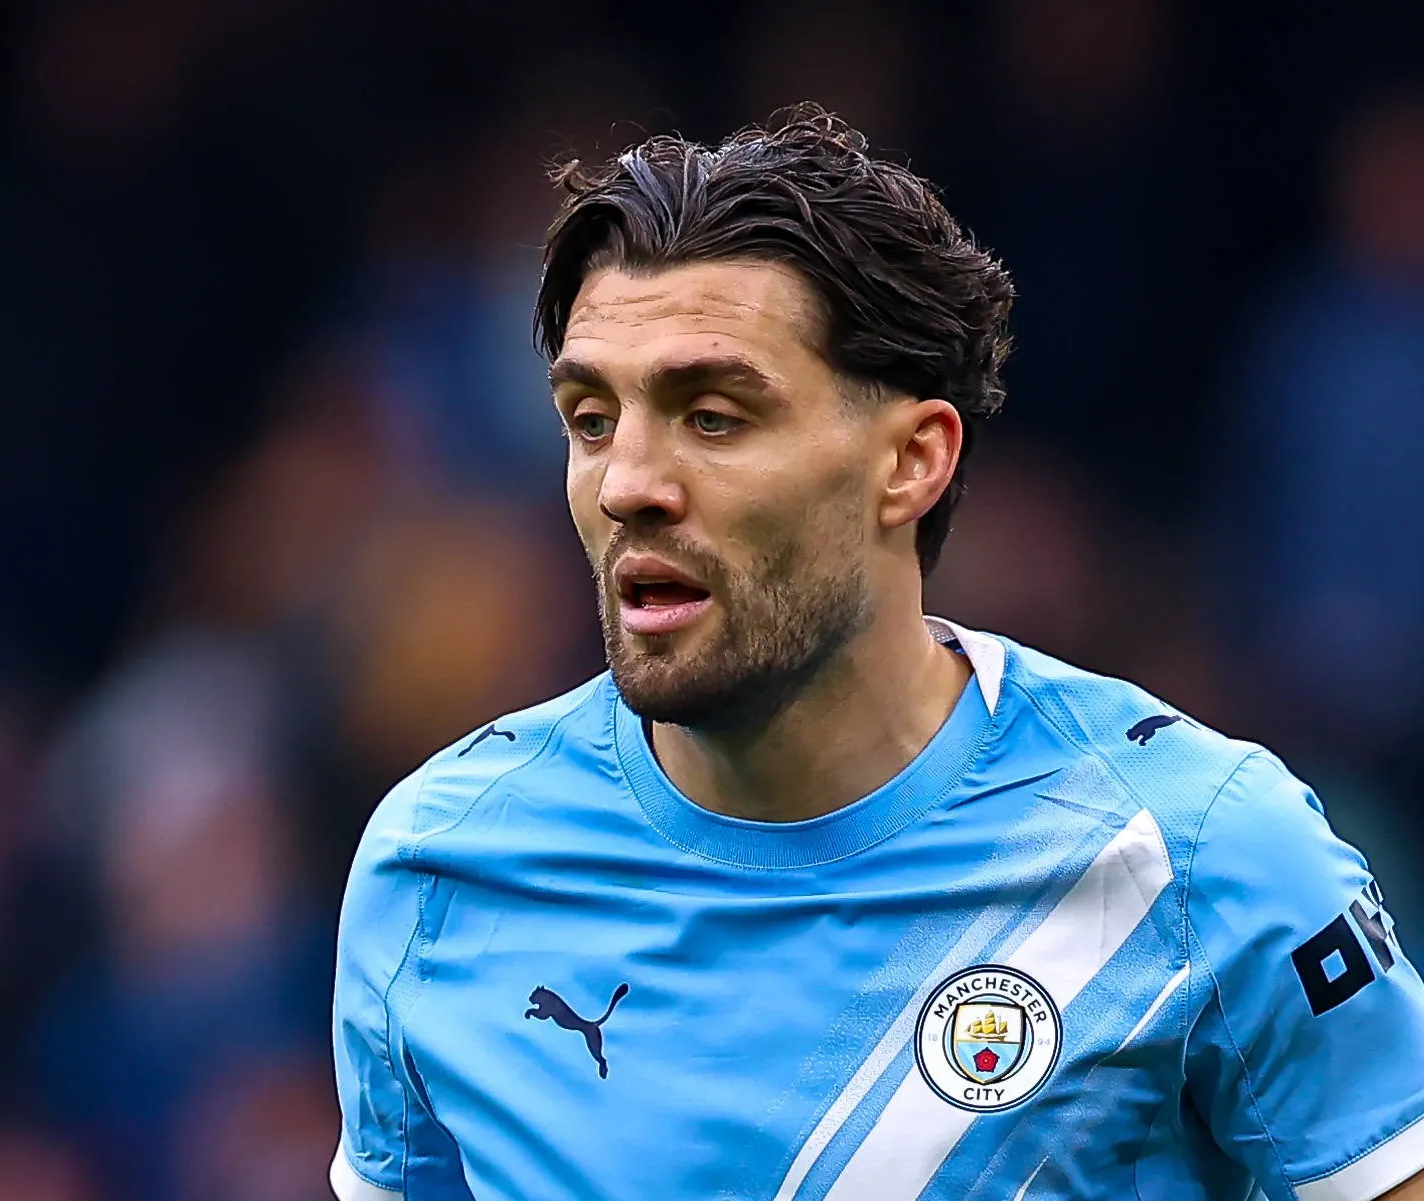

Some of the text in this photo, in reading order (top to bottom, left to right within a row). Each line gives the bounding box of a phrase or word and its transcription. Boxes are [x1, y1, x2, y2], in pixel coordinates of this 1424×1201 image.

[1291, 878, 1396, 1018] OK
[933, 977, 1047, 1024] MANCHESTER
[1037, 1037, 1051, 1046] 94
[963, 1087, 1005, 1101] CITY
